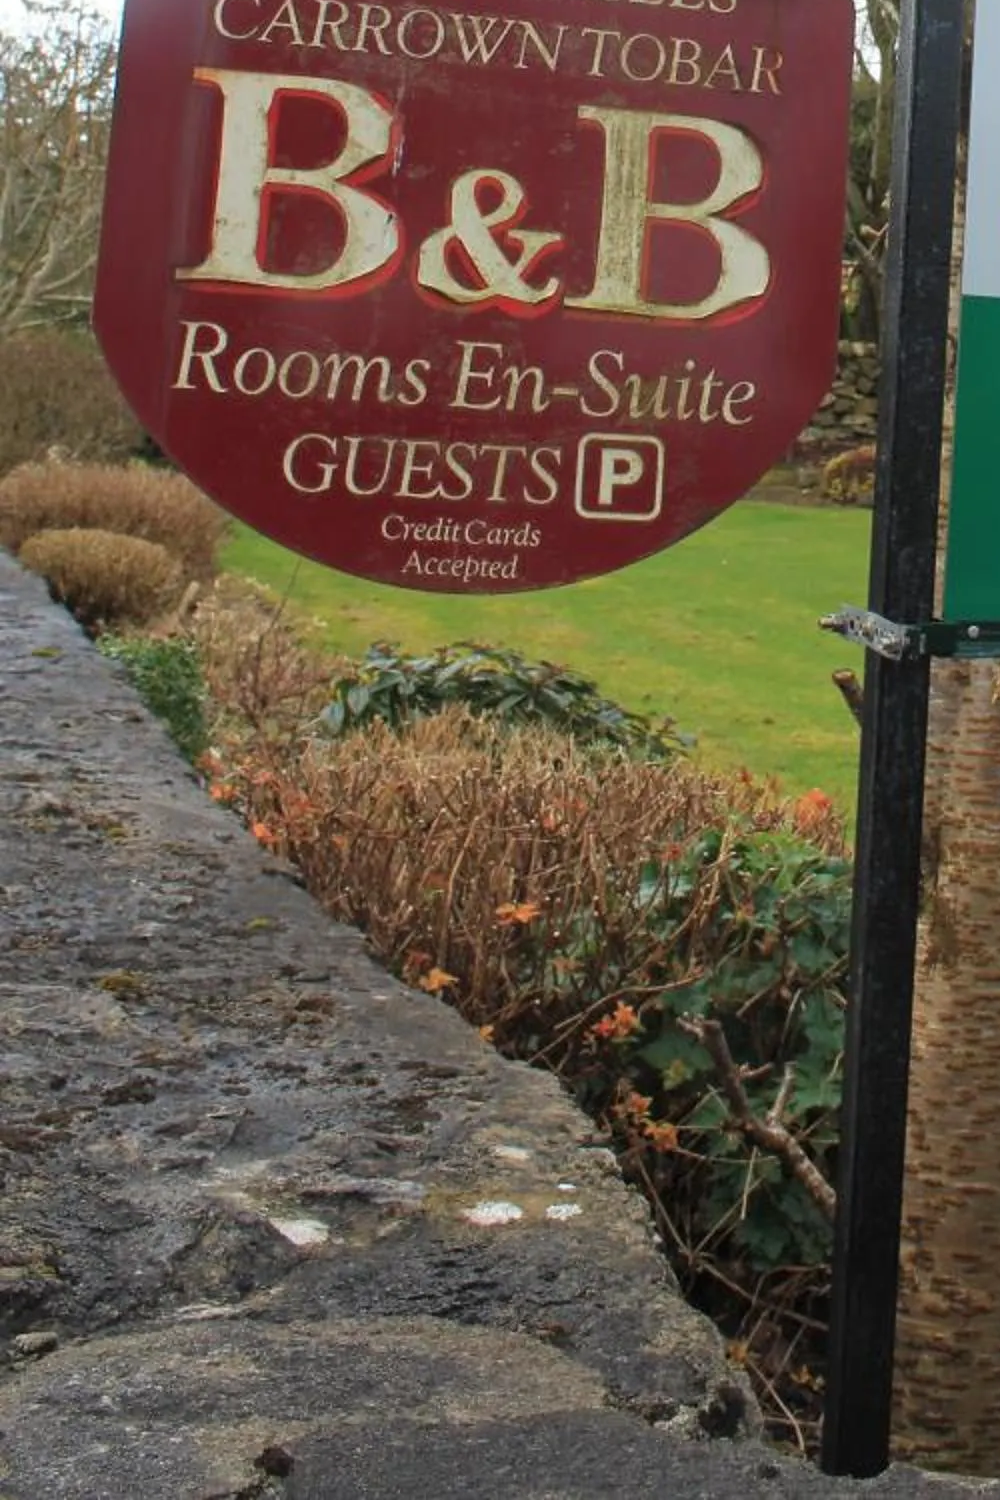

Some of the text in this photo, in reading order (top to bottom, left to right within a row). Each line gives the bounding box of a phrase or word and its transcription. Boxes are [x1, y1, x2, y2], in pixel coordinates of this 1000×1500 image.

[581, 27, 784, 95] TOBAR
[170, 320, 756, 425] Rooms En-Suite
[282, 432, 644, 505] GUESTS P
[381, 514, 542, 548] Credit Cards
[401, 550, 519, 583] Accepted
